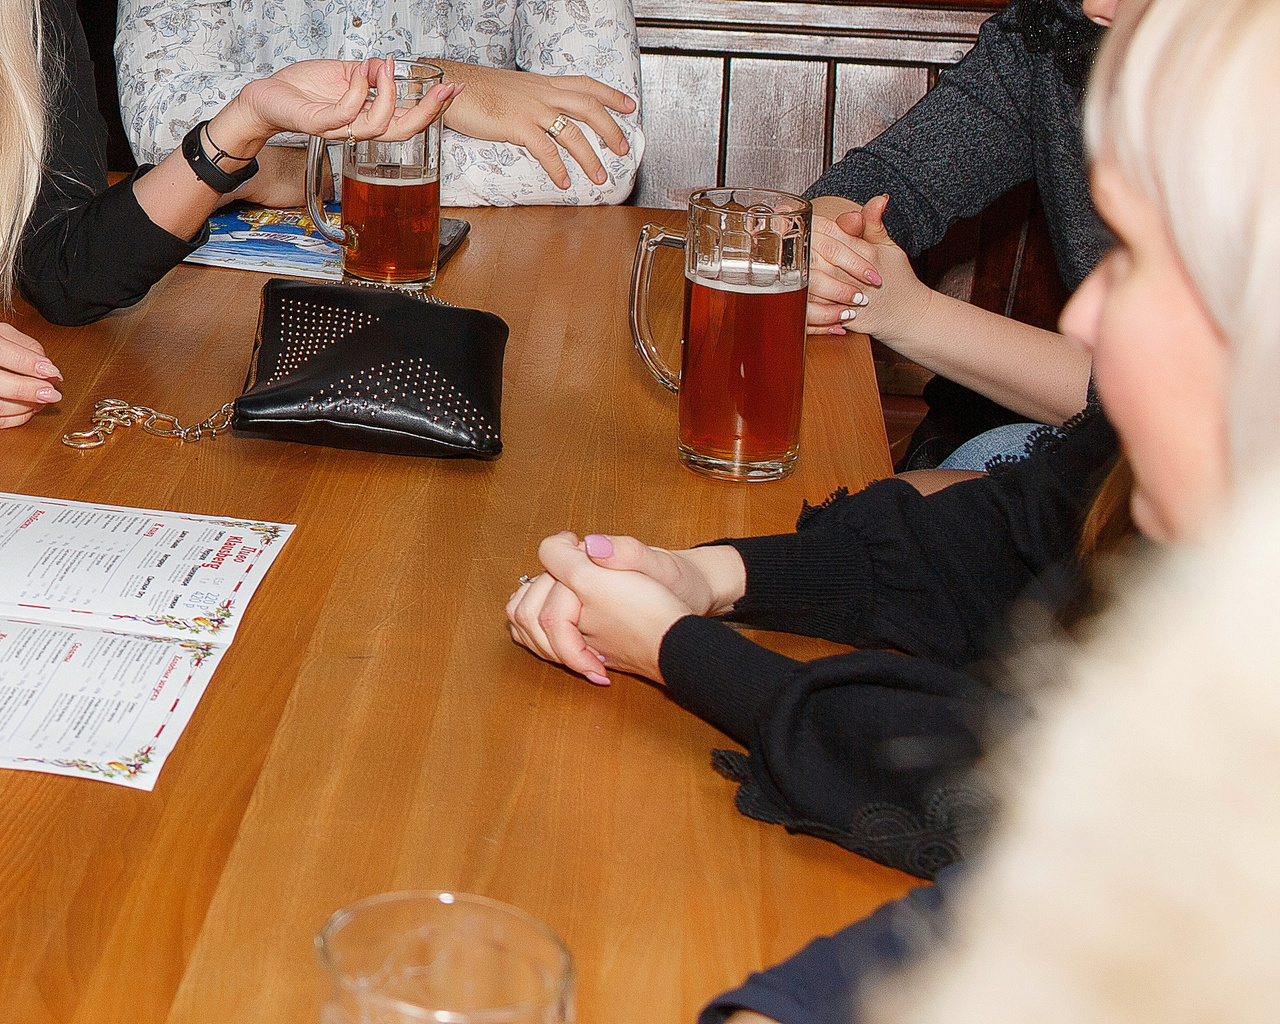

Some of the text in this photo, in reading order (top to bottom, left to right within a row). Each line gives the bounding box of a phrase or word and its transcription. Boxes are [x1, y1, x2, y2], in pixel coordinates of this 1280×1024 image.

[202, 535, 243, 570] Klausberg
[233, 545, 257, 563] Пиво
[189, 591, 205, 602] 420
[203, 592, 220, 604] 220
